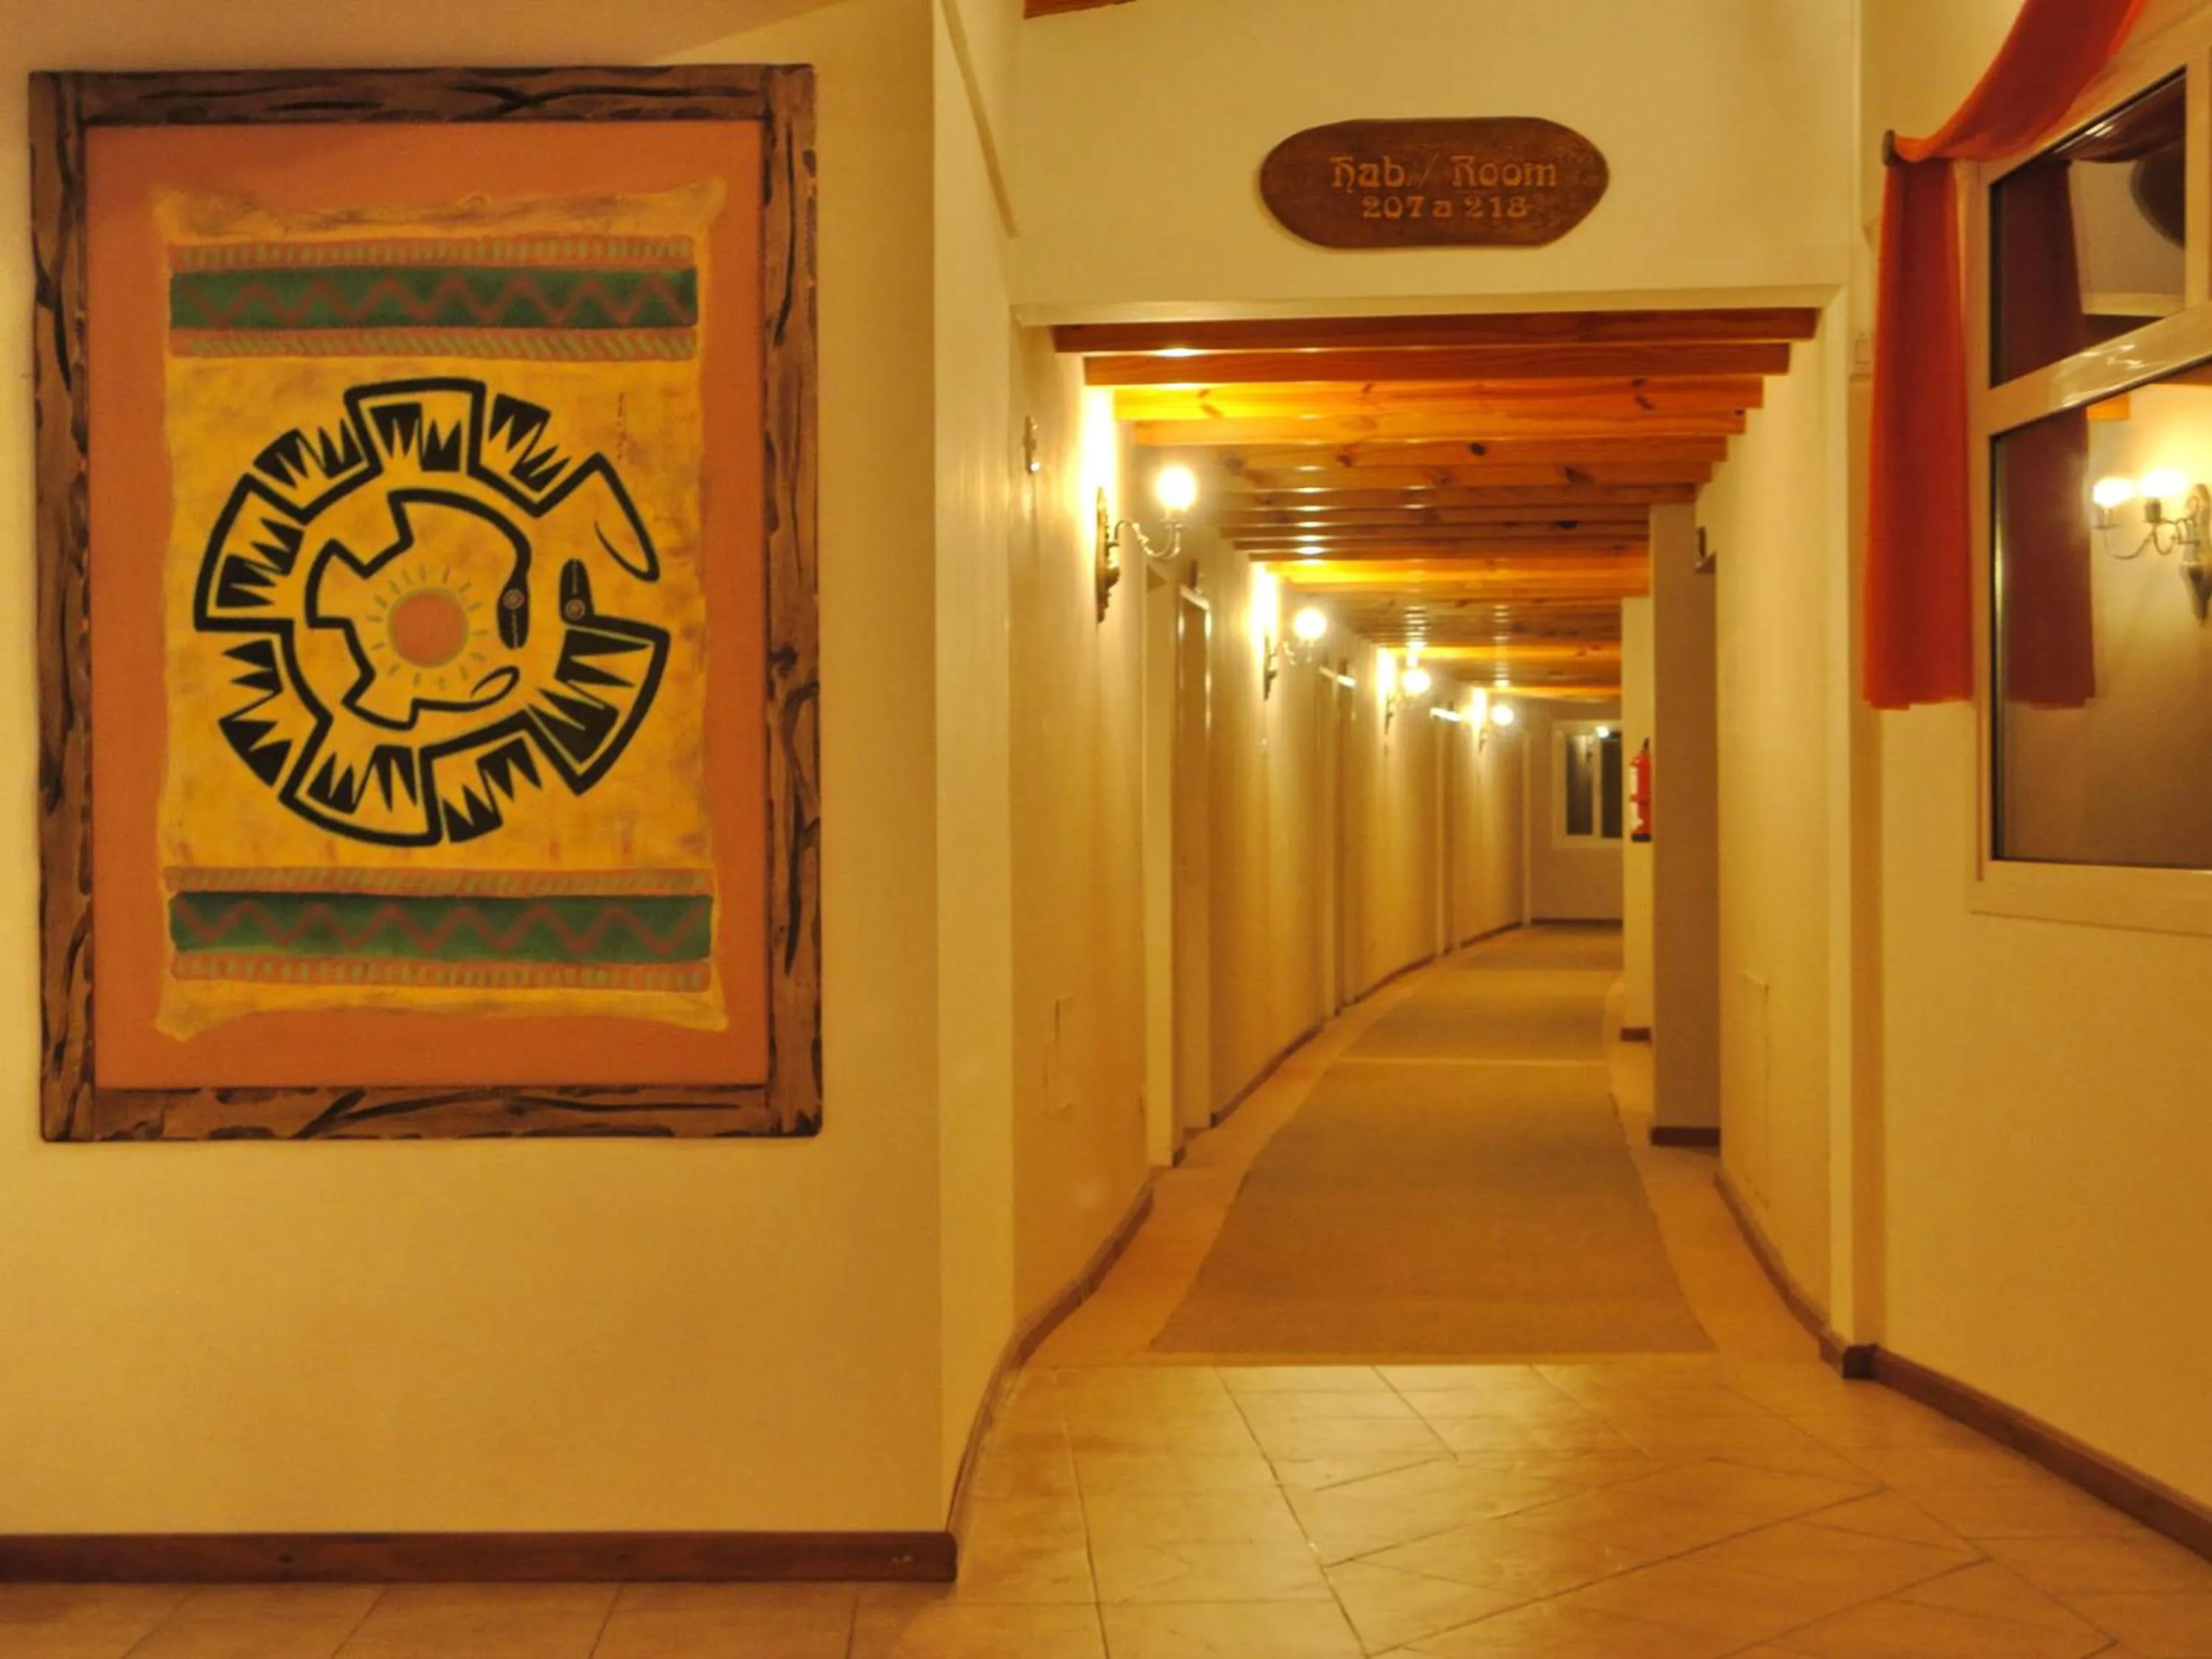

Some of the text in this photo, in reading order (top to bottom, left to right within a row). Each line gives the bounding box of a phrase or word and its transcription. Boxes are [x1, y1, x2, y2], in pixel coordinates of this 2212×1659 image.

[1448, 154, 1557, 187] Room
[1362, 195, 1528, 219] 207 a 218
